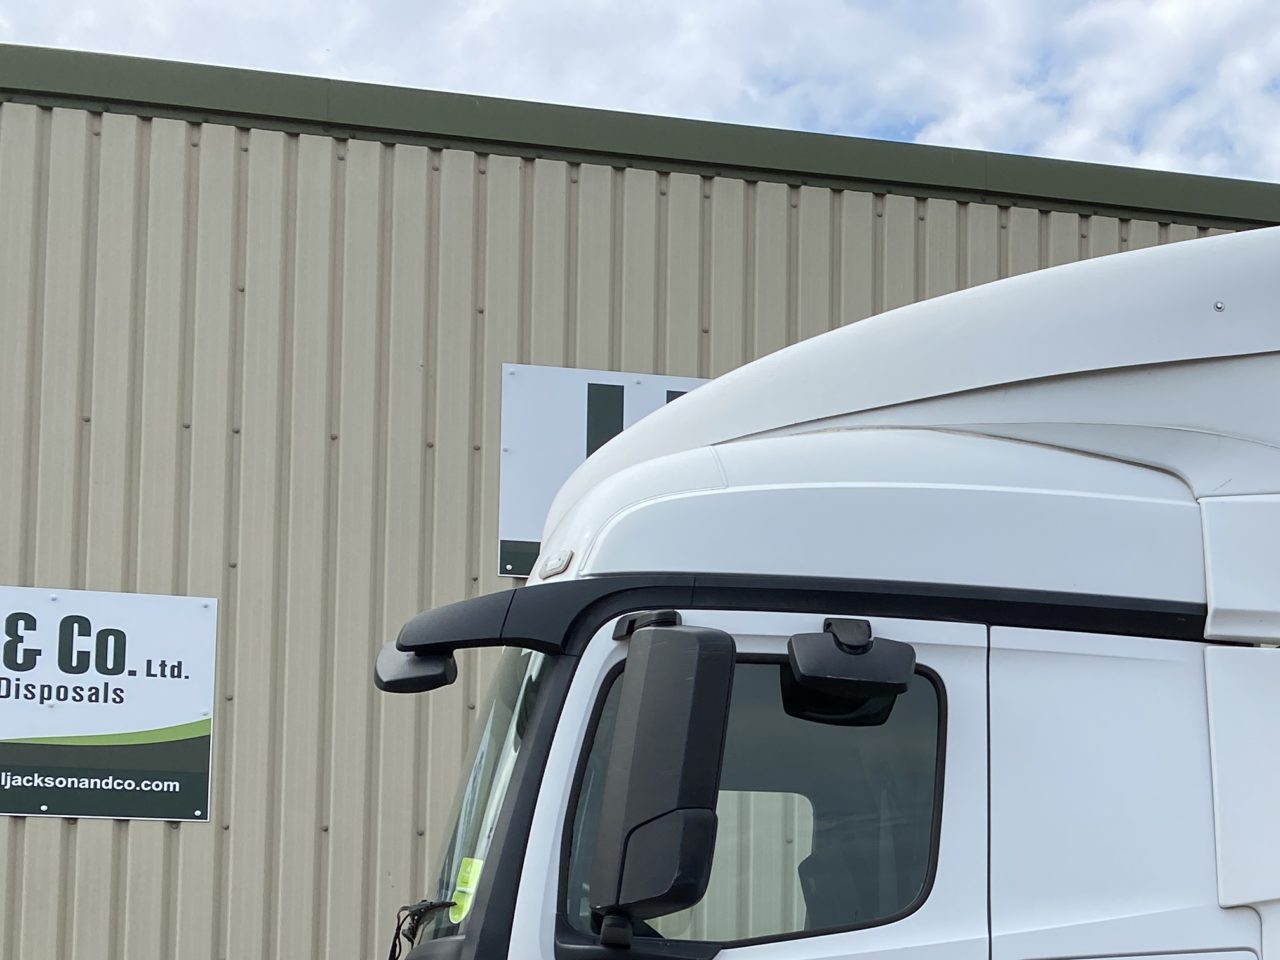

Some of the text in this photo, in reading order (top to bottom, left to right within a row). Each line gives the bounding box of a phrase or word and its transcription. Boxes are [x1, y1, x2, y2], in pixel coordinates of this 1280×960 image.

[3, 612, 190, 680] & Co. Ltd.
[0, 677, 125, 705] Disposals
